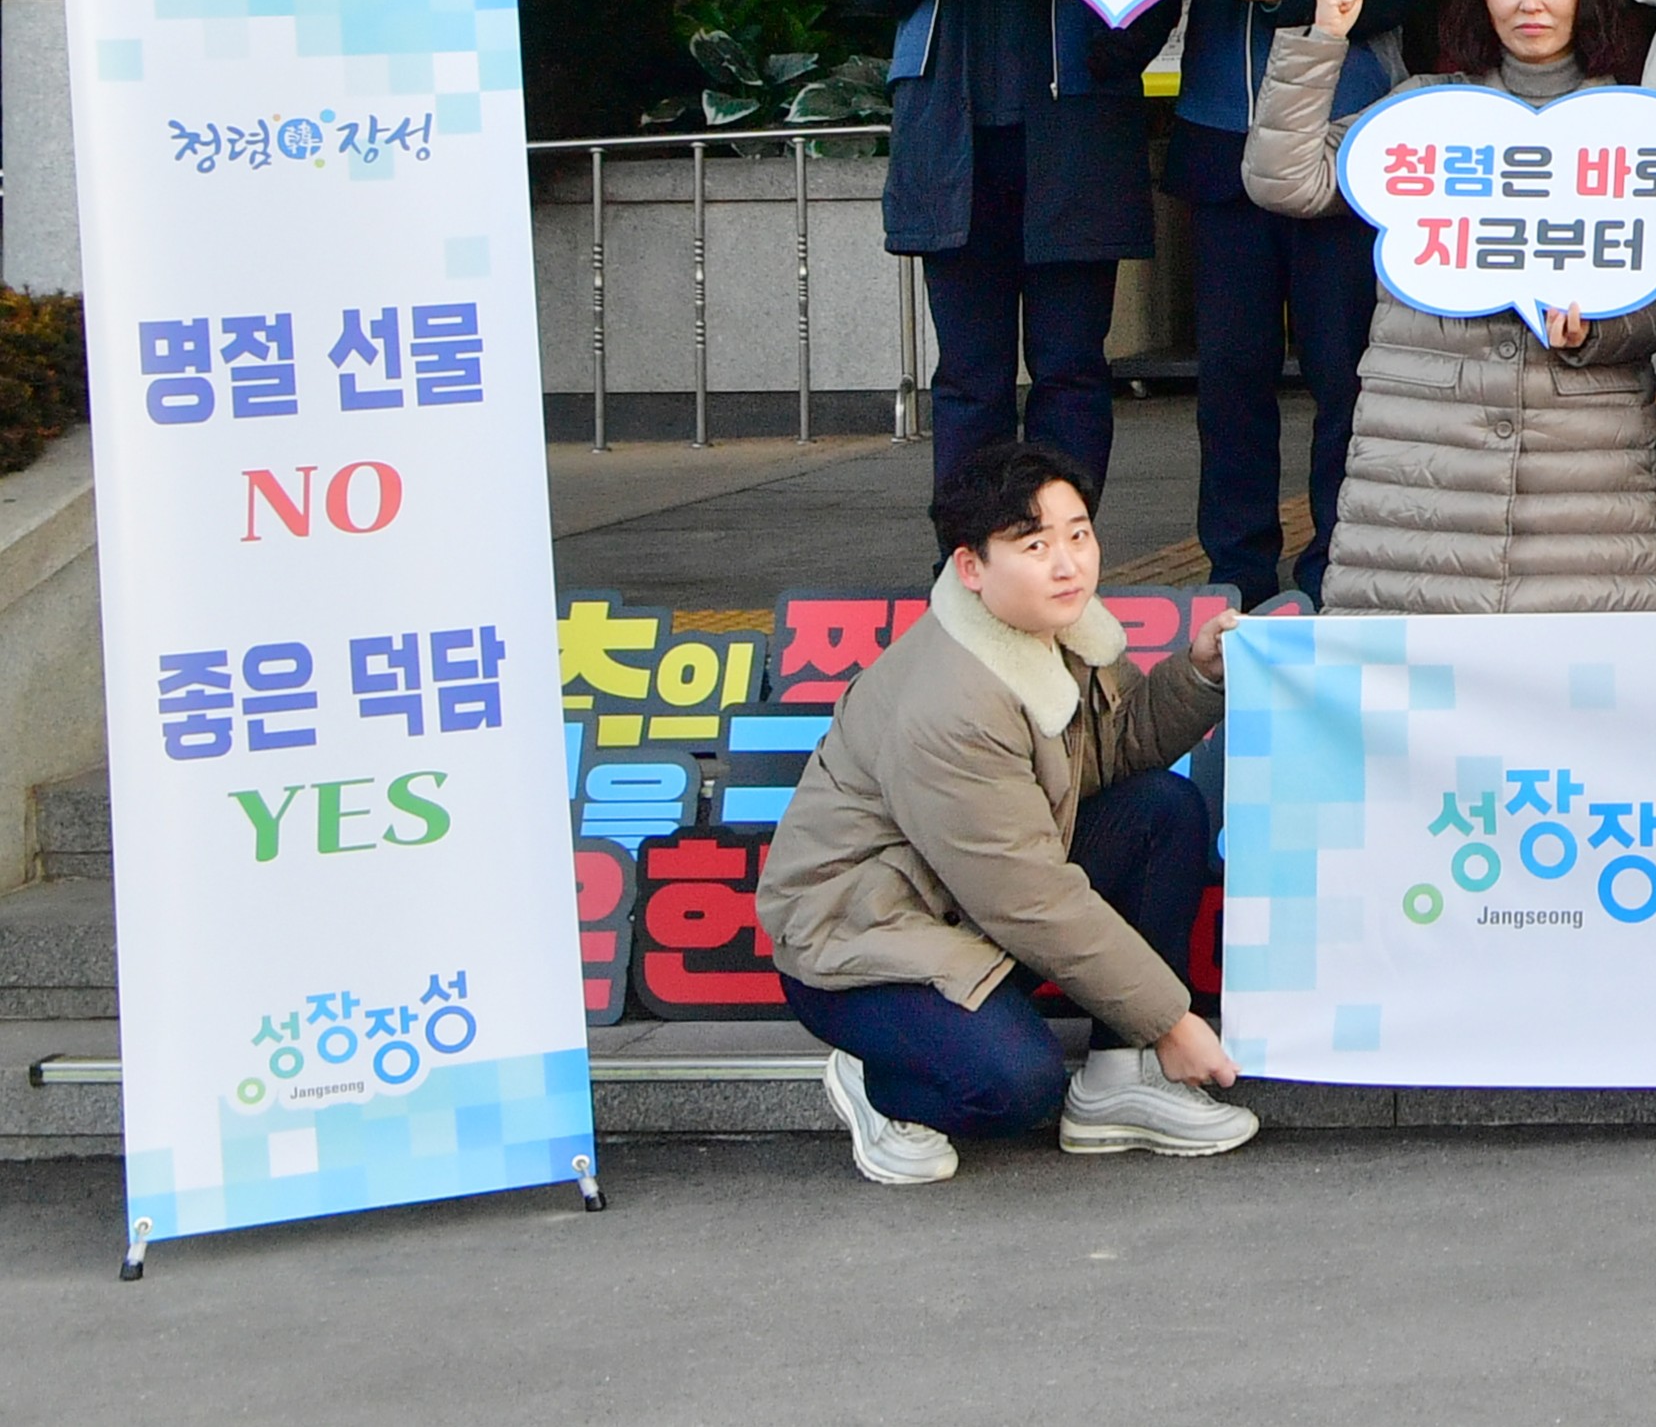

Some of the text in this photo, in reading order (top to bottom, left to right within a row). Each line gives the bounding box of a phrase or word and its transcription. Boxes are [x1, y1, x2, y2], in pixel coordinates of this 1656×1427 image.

[1384, 144, 1553, 197] 청렴은
[1415, 217, 1644, 270] 지금부터
[140, 303, 483, 424] 명절 선물
[242, 462, 402, 541] NO
[159, 626, 505, 760] 좋은 덕담
[228, 772, 450, 862] YES
[1478, 907, 1582, 928] Jangseong
[249, 970, 478, 1085] 성장장성
[288, 1078, 366, 1102] Jangseong
